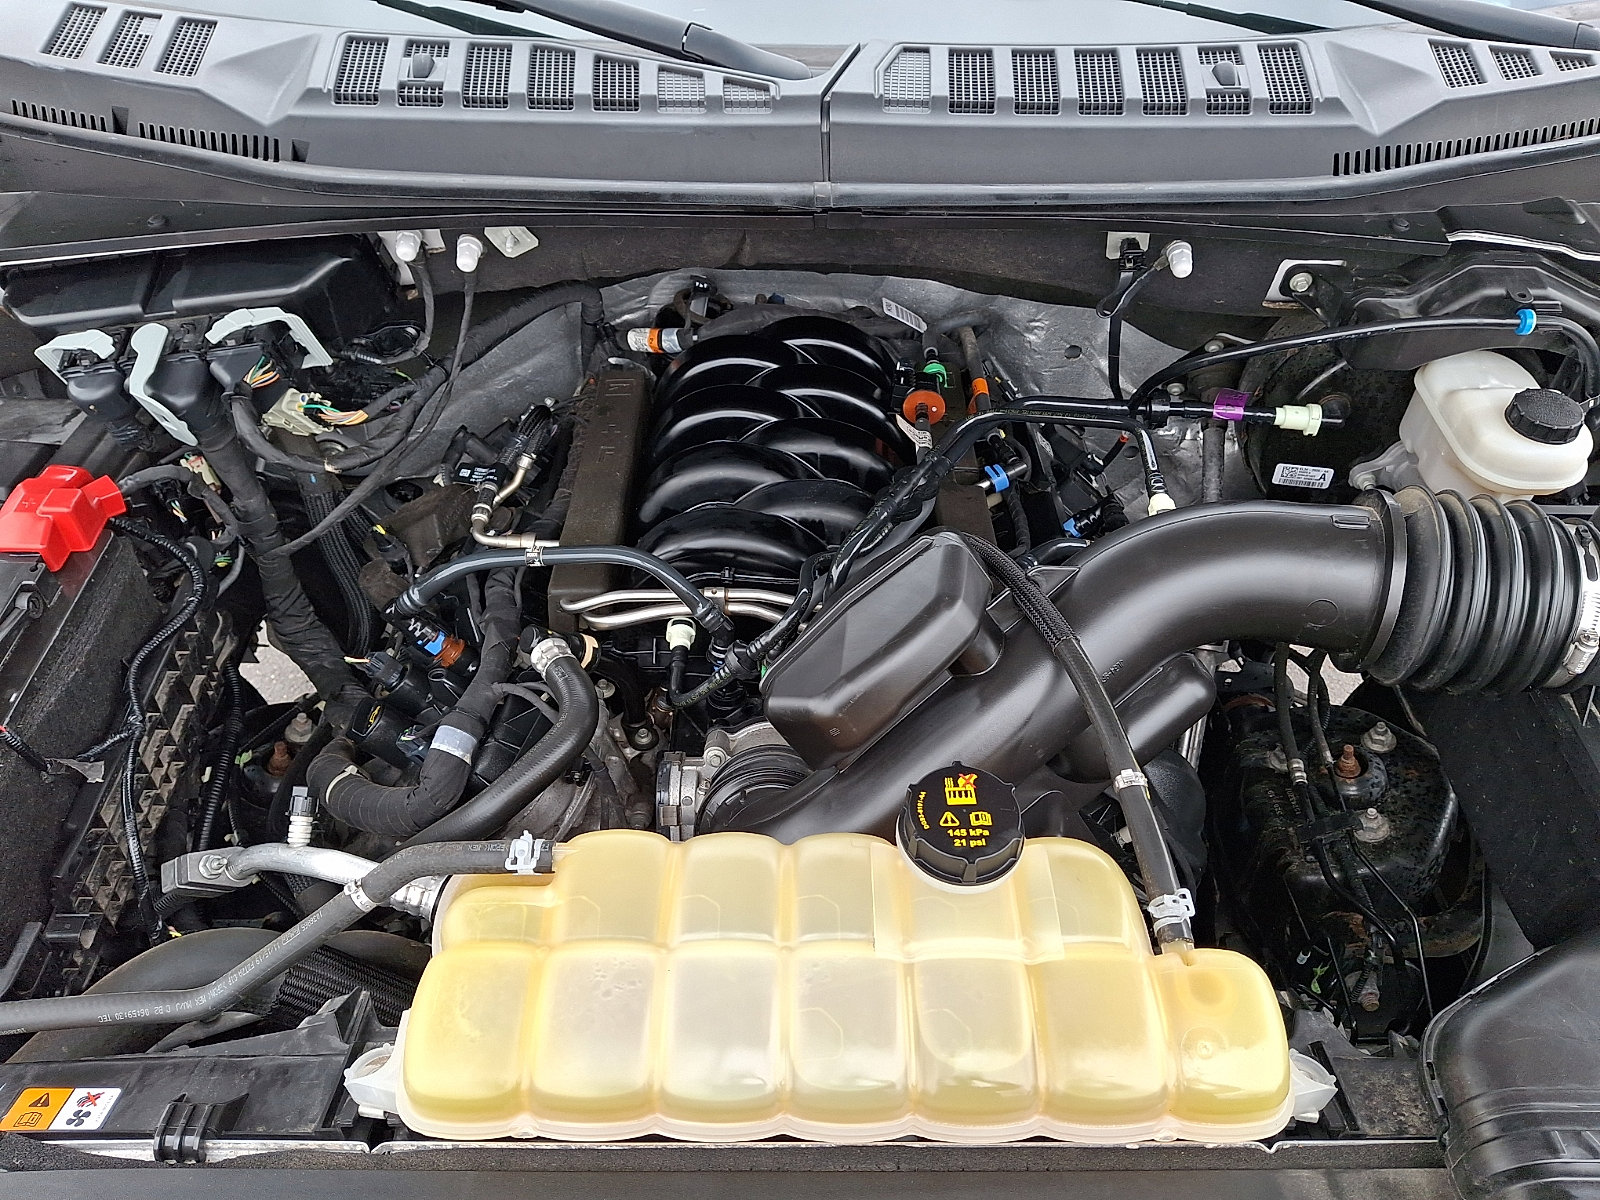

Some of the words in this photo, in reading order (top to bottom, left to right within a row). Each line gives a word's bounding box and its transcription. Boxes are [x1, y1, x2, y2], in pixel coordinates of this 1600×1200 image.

[947, 828, 967, 837] 145
[969, 828, 990, 836] kPa
[954, 839, 967, 847] 21
[970, 838, 986, 847] psi
[97, 1014, 113, 1023] TEC
